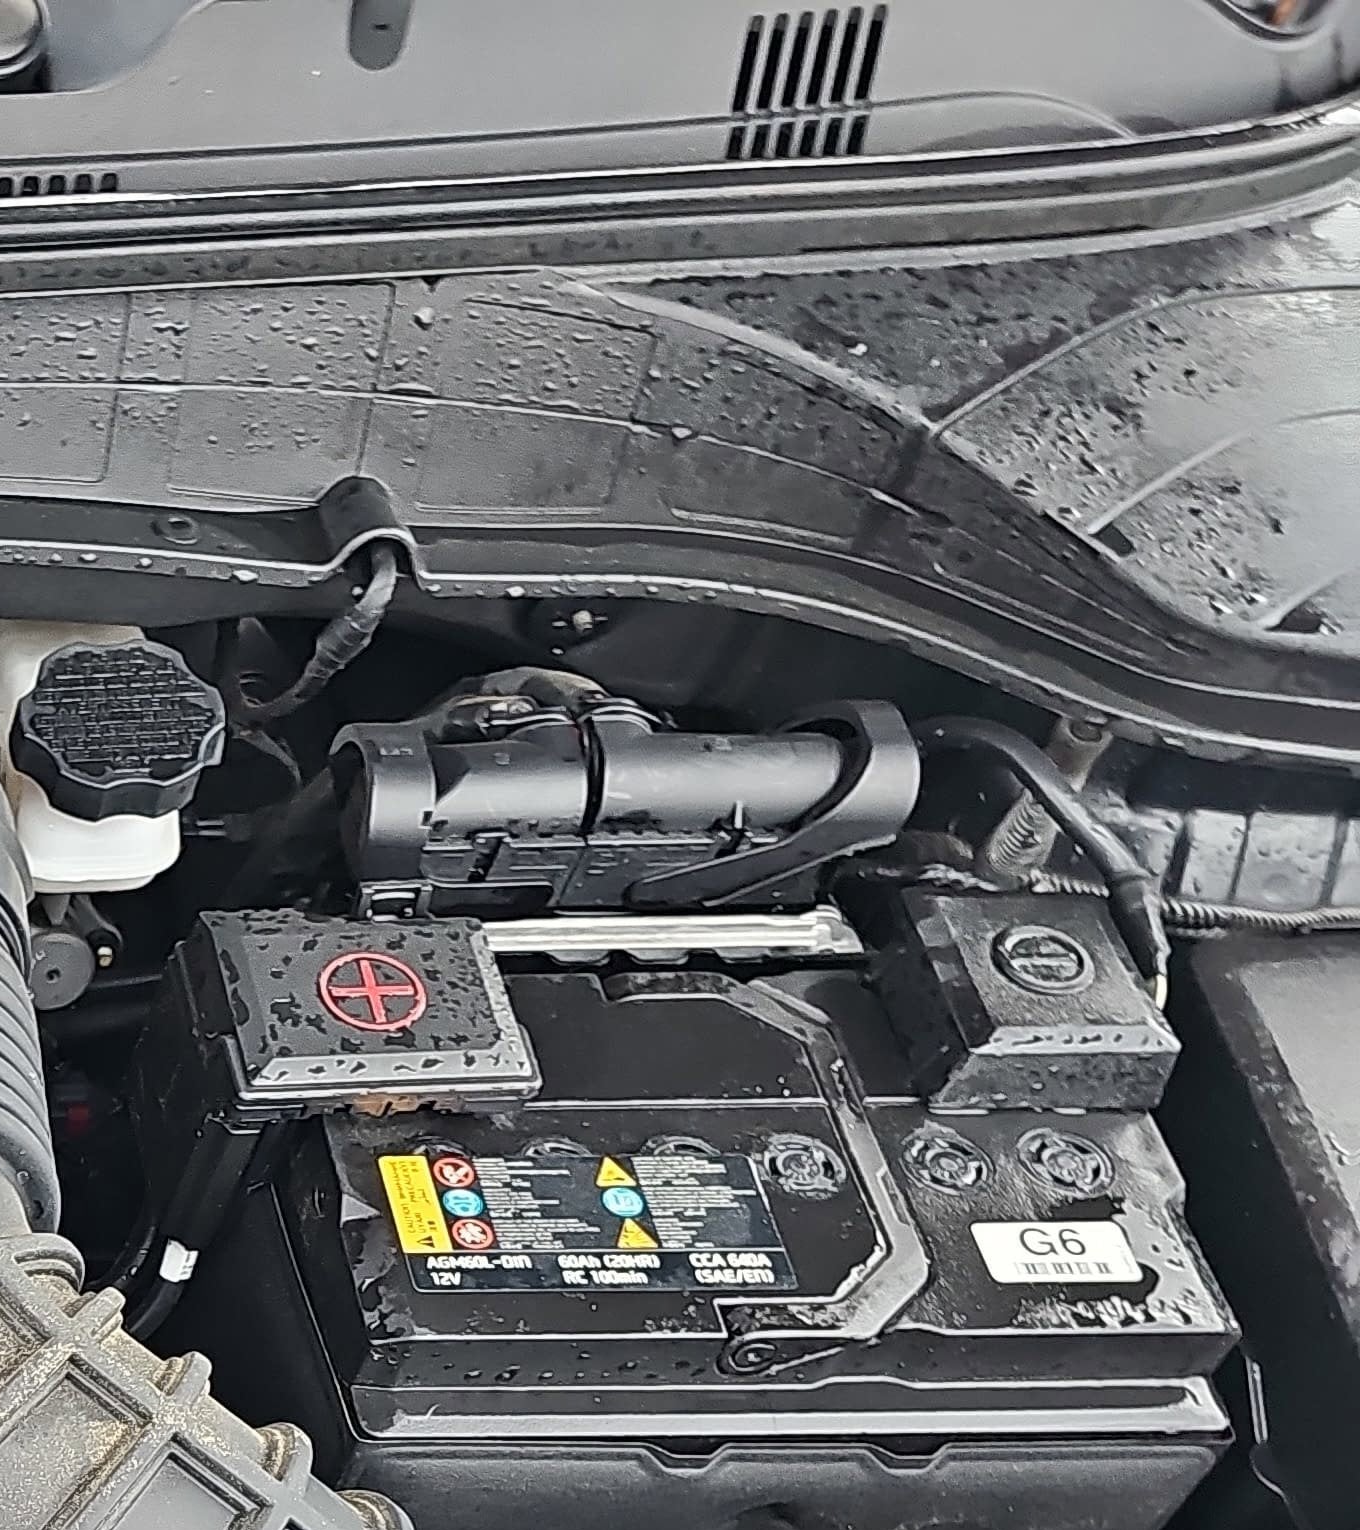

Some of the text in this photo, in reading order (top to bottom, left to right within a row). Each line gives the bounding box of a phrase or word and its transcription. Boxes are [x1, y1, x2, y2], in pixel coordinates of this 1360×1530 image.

[1019, 1227, 1087, 1256] G6
[689, 1253, 727, 1268] CCA
[430, 1271, 462, 1286] 12V
[562, 1270, 587, 1285] RC
[591, 1270, 649, 1285] 100min
